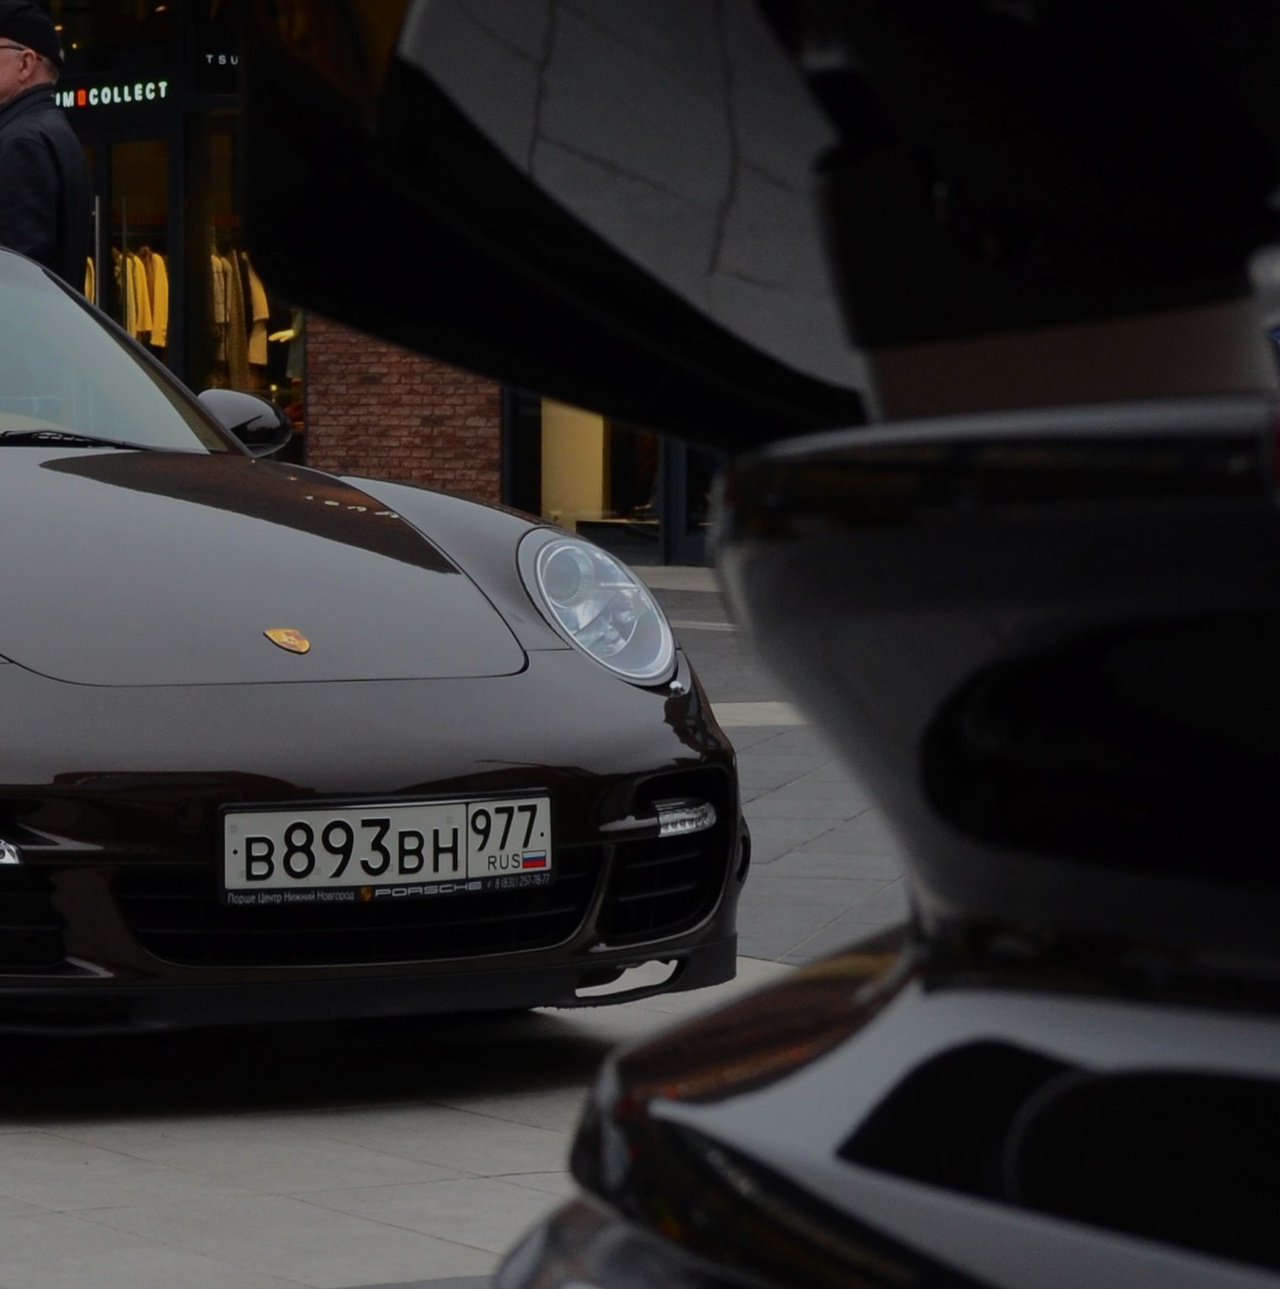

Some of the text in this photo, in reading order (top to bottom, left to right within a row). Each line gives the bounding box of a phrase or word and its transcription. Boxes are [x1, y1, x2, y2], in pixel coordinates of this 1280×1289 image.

[88, 80, 169, 107] COLLECT
[245, 804, 538, 882] В893ВН 977
[487, 854, 520, 871] RUS
[227, 889, 355, 905] Порше Центр Нижний Новгород
[374, 880, 483, 898] PORSCHE
